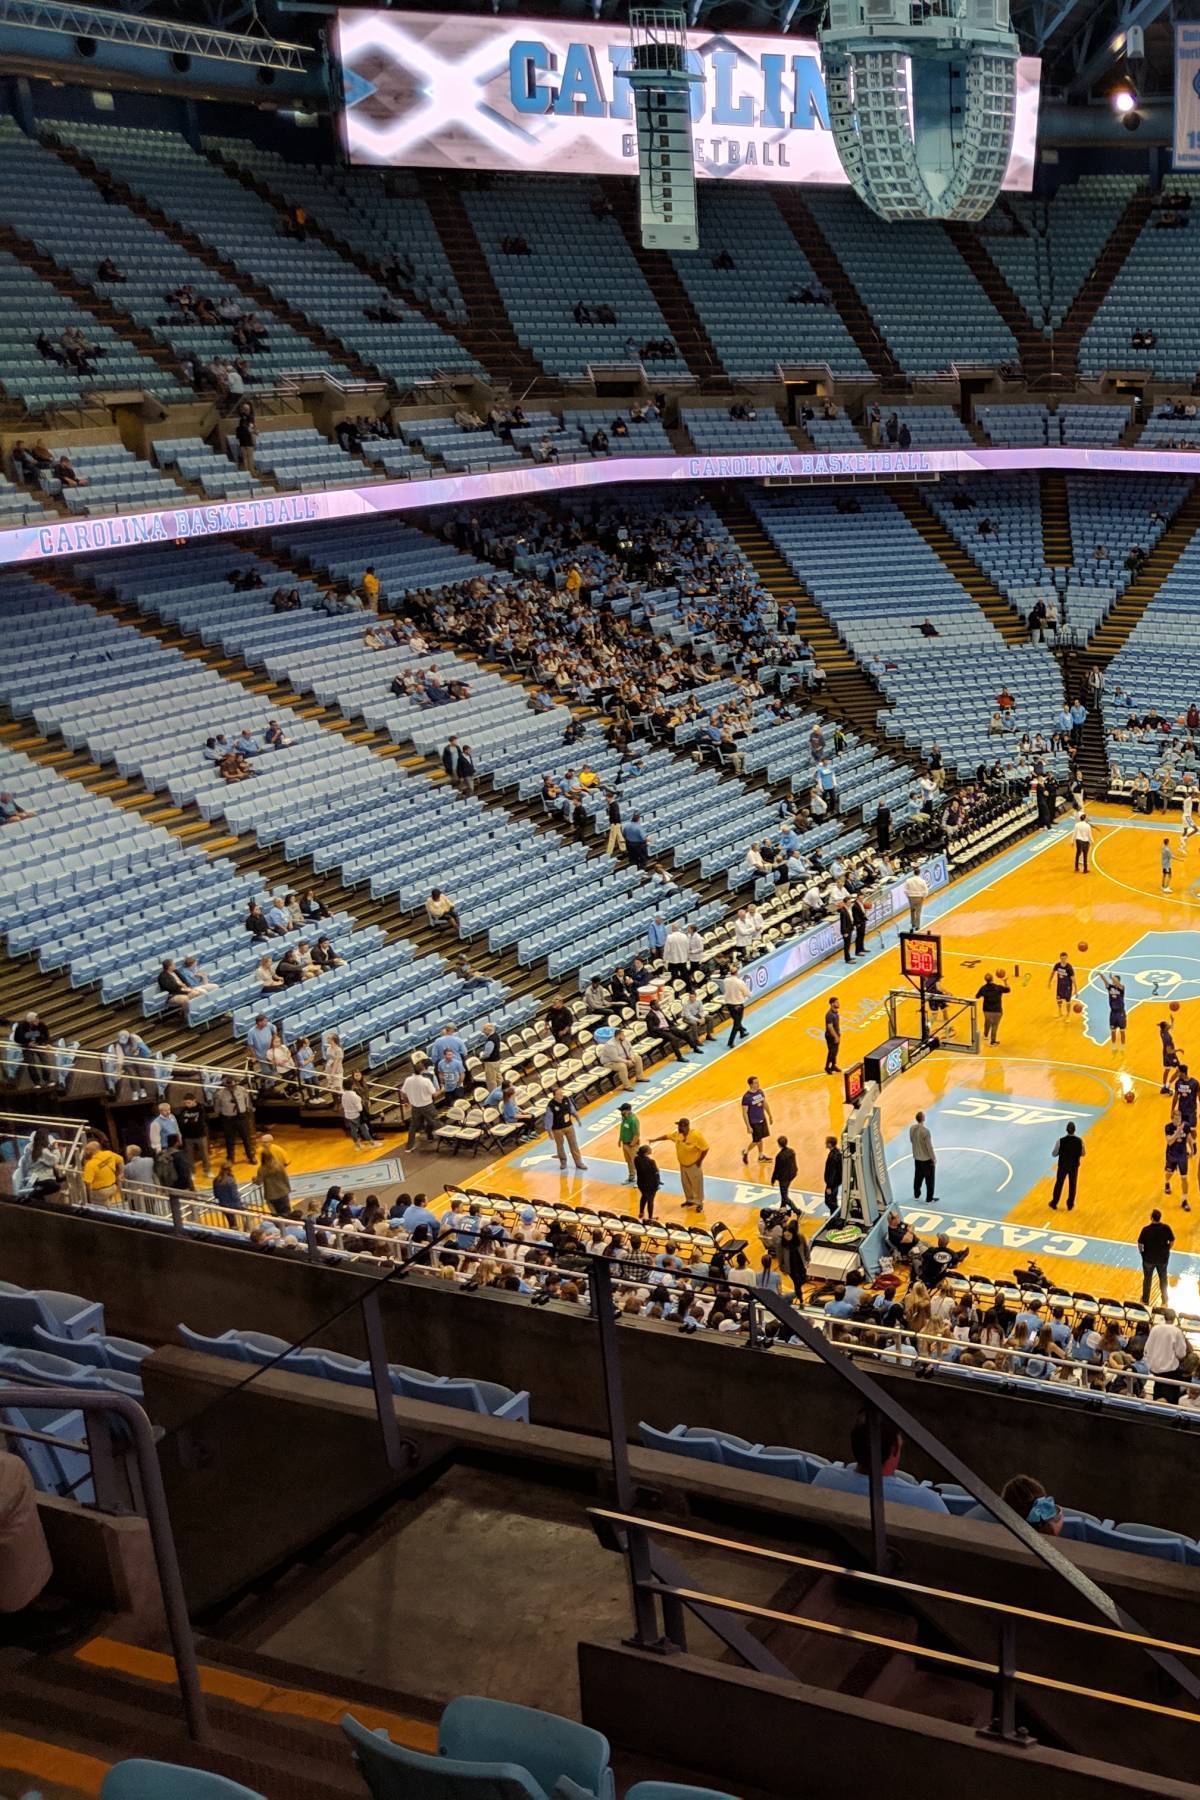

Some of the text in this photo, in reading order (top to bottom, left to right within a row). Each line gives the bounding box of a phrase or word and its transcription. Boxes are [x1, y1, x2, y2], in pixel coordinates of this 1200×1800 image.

[509, 40, 833, 130] CALIN
[622, 134, 790, 167] BETBALL
[689, 453, 929, 477] CAROLINA BASKETBALL
[39, 496, 315, 554] CAROLINA BASKETBALL
[910, 952, 932, 971] 30
[586, 1063, 702, 1132] GOHELS.COM
[938, 1098, 1090, 1125] ACC
